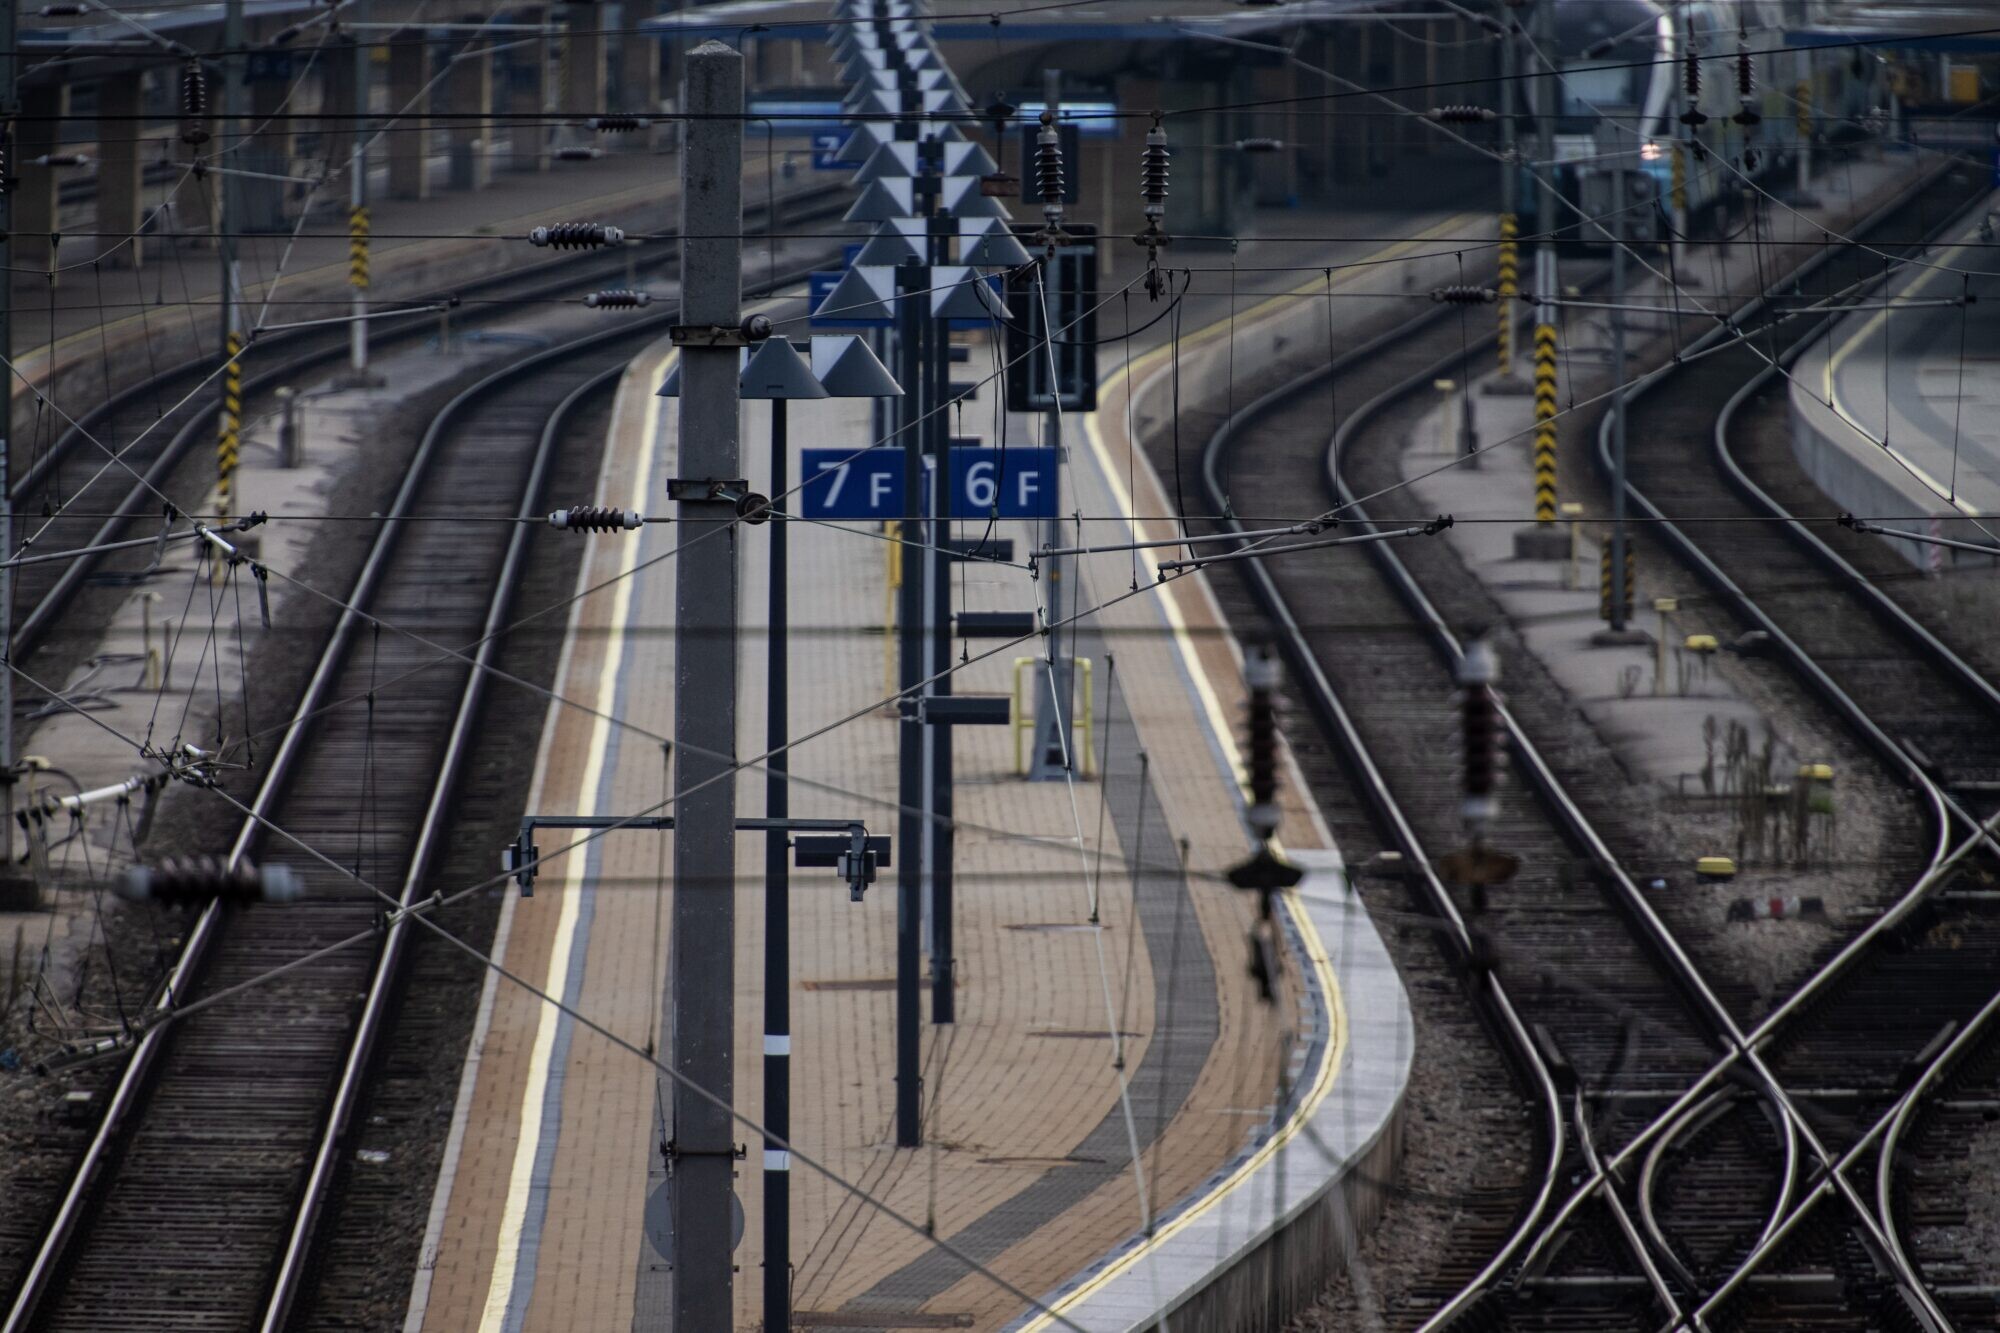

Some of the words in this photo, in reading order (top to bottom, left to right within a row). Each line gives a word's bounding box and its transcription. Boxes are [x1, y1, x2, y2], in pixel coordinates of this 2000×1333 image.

[818, 461, 850, 508] 7
[870, 473, 892, 507] F
[965, 461, 997, 507] 6
[1018, 471, 1040, 507] F
